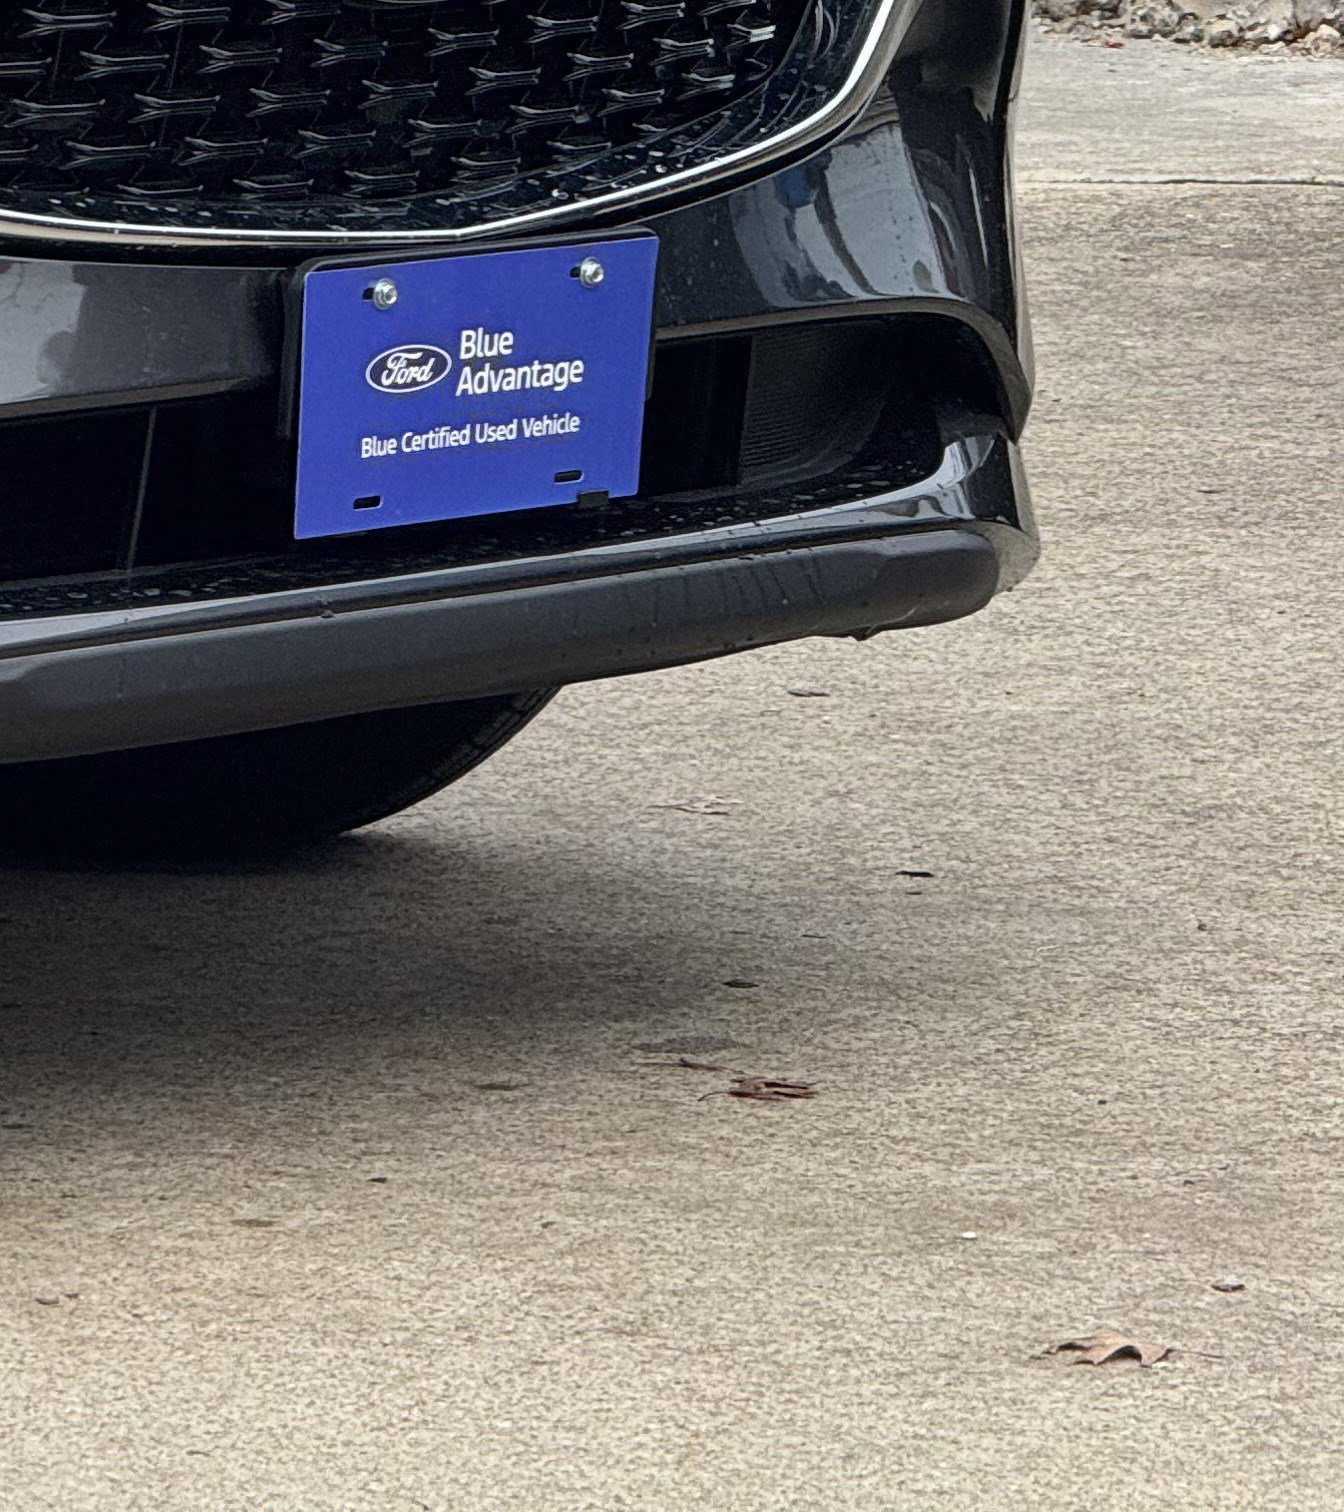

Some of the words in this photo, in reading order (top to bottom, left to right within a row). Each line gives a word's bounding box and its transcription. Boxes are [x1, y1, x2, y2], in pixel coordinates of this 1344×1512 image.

[459, 327, 514, 360] Blue
[380, 351, 435, 387] Ford
[455, 357, 584, 397] Advantage
[360, 436, 397, 459] Blue
[401, 423, 471, 454] Certified
[475, 418, 517, 443] Used
[522, 411, 581, 437] Vehicle
